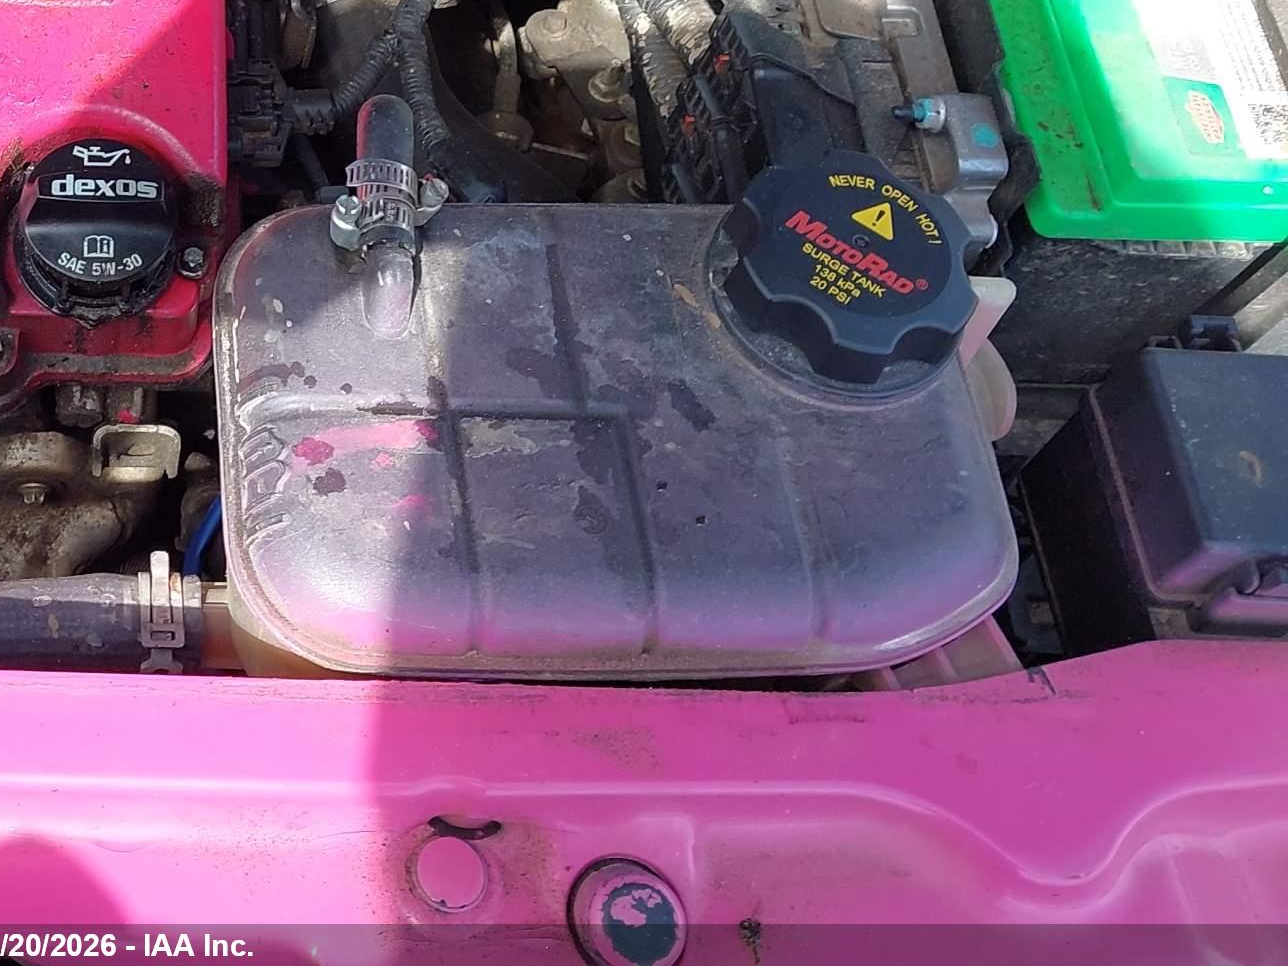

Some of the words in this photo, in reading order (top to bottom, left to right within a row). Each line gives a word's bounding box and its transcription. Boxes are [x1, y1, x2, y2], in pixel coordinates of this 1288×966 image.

[51, 174, 159, 199] dexos
[828, 174, 876, 190] NEVER
[881, 185, 917, 213] OPEN
[57, 252, 86, 275] SAE
[801, 242, 850, 276] SURGE
[852, 270, 887, 298] TANK
[809, 276, 827, 291] 20
[828, 285, 853, 306] PSI
[813, 264, 835, 283] 138
[837, 277, 861, 298] kPa
